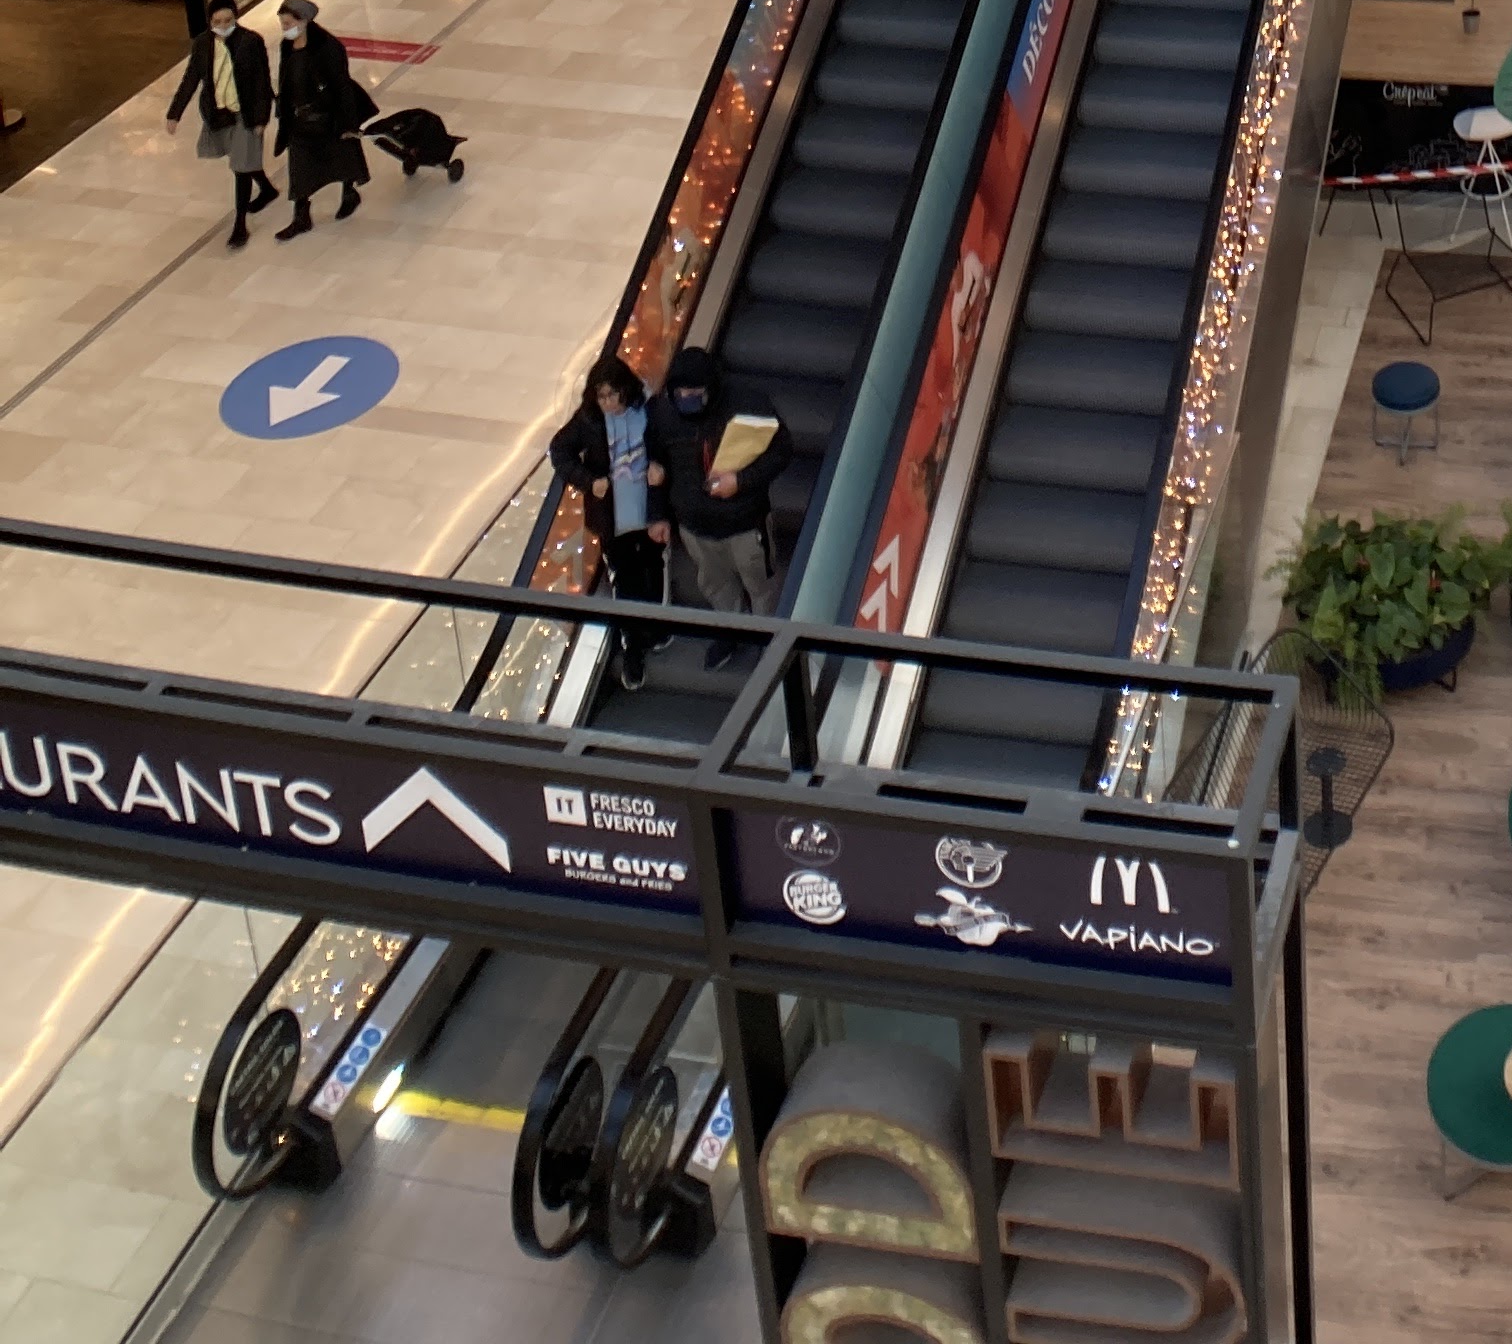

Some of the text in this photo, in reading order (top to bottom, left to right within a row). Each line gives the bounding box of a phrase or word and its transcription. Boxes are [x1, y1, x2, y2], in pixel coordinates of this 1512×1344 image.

[0, 732, 341, 846] URANTS
[590, 792, 655, 817] FRESCO
[593, 813, 678, 839] EVERYDAY
[547, 846, 688, 882] FIVE GUYS
[564, 868, 673, 892] BURGERS and FRIES
[789, 881, 839, 898] BURGER
[793, 892, 842, 912] KING
